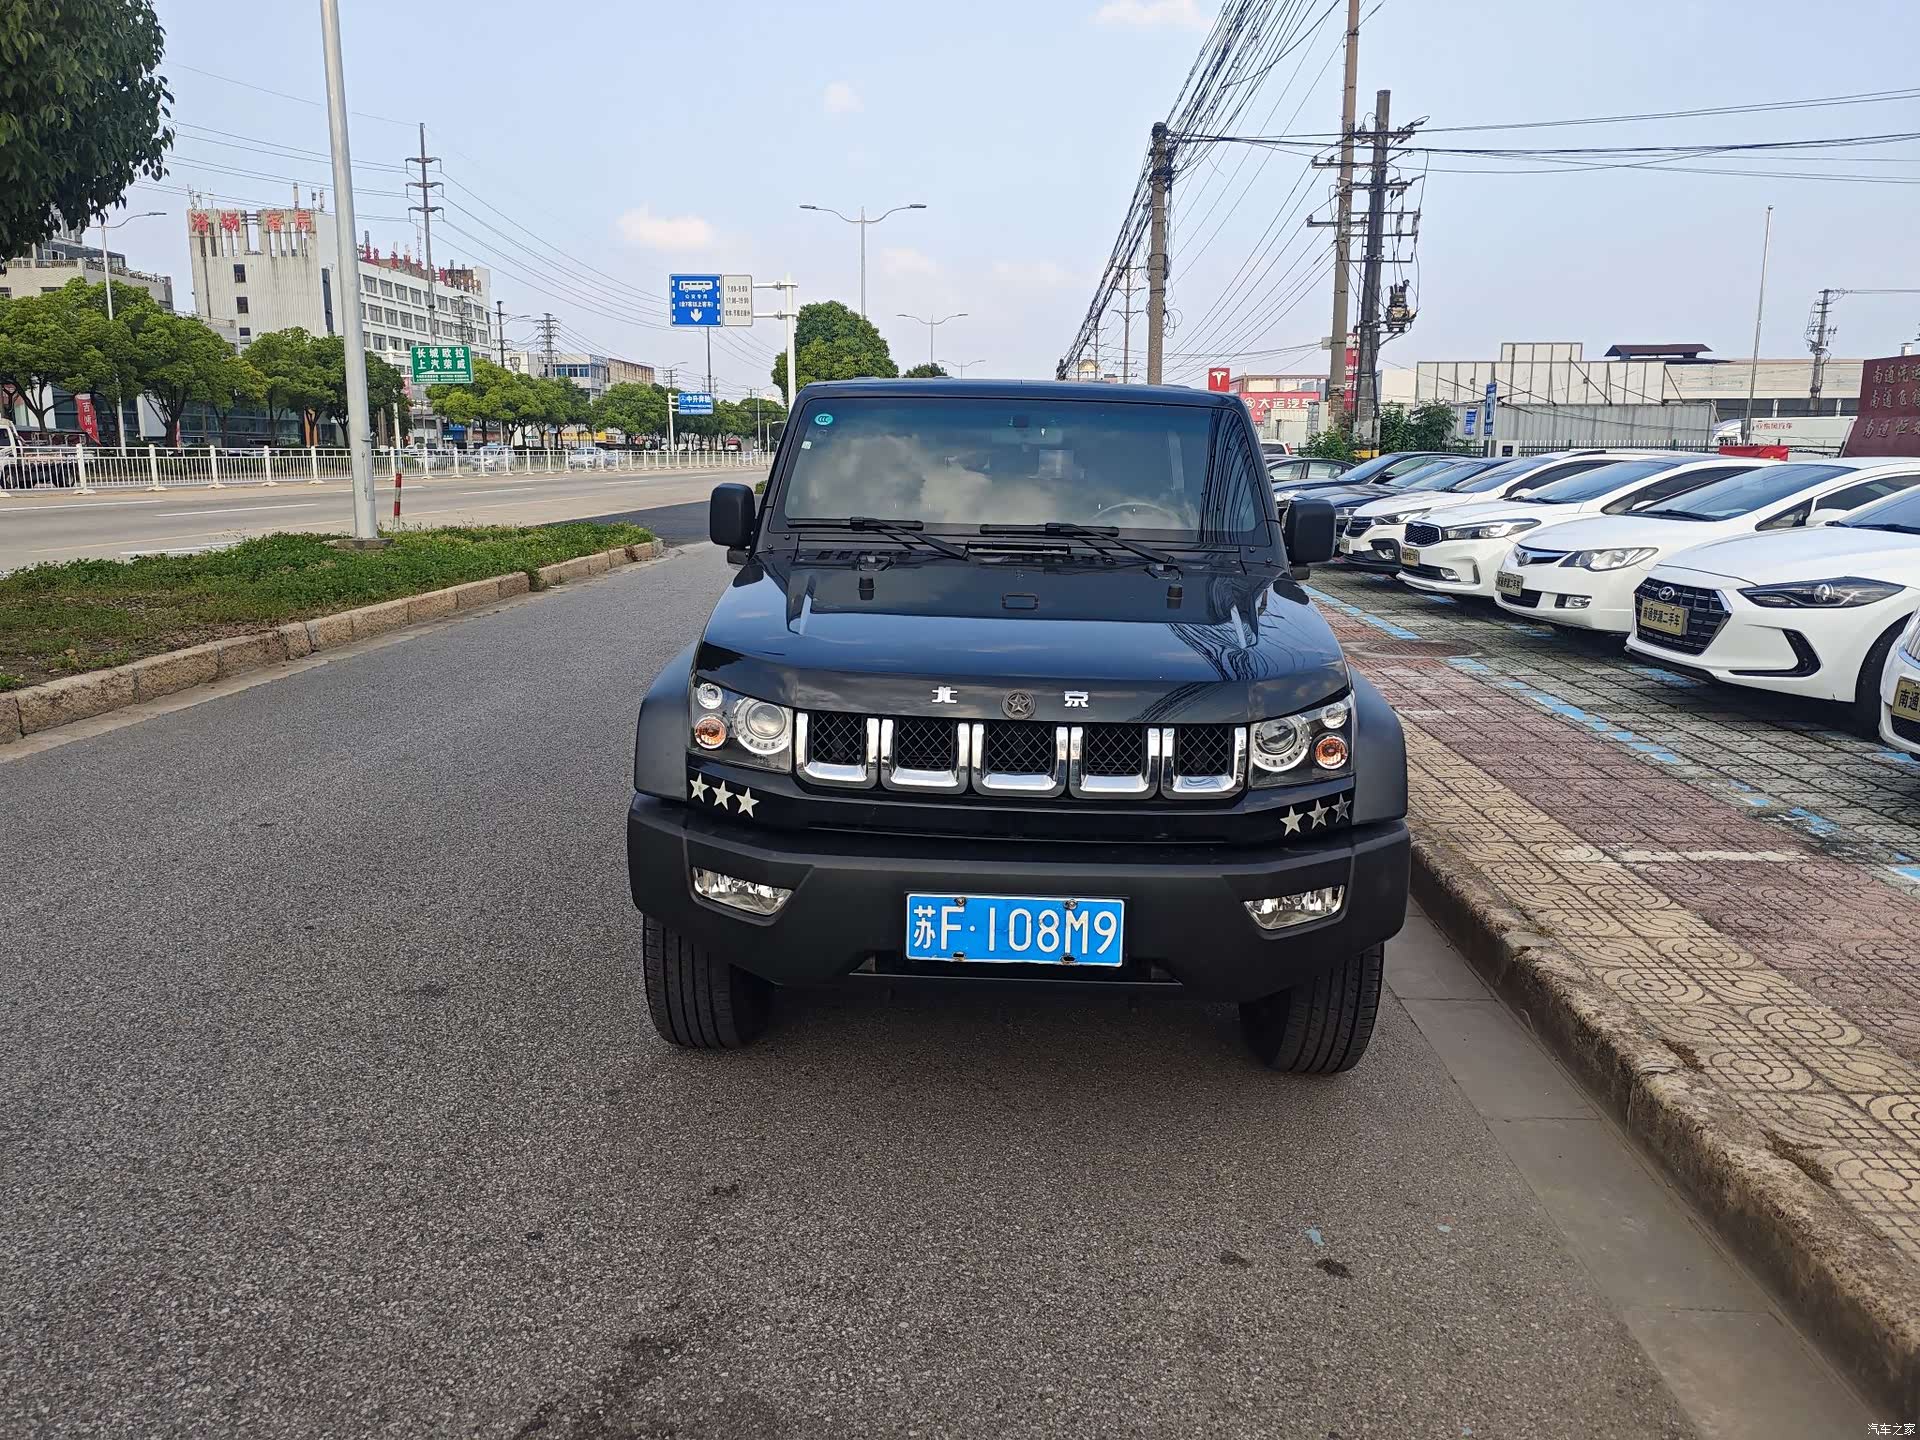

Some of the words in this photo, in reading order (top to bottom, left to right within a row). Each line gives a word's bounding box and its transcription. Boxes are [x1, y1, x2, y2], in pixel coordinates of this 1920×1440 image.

[191, 212, 239, 232] 浴场
[267, 211, 310, 232] 客房
[416, 347, 465, 359] 长城欧拉
[417, 358, 466, 370] 上汽荣威
[932, 686, 958, 703] 北
[1064, 691, 1089, 707] 京
